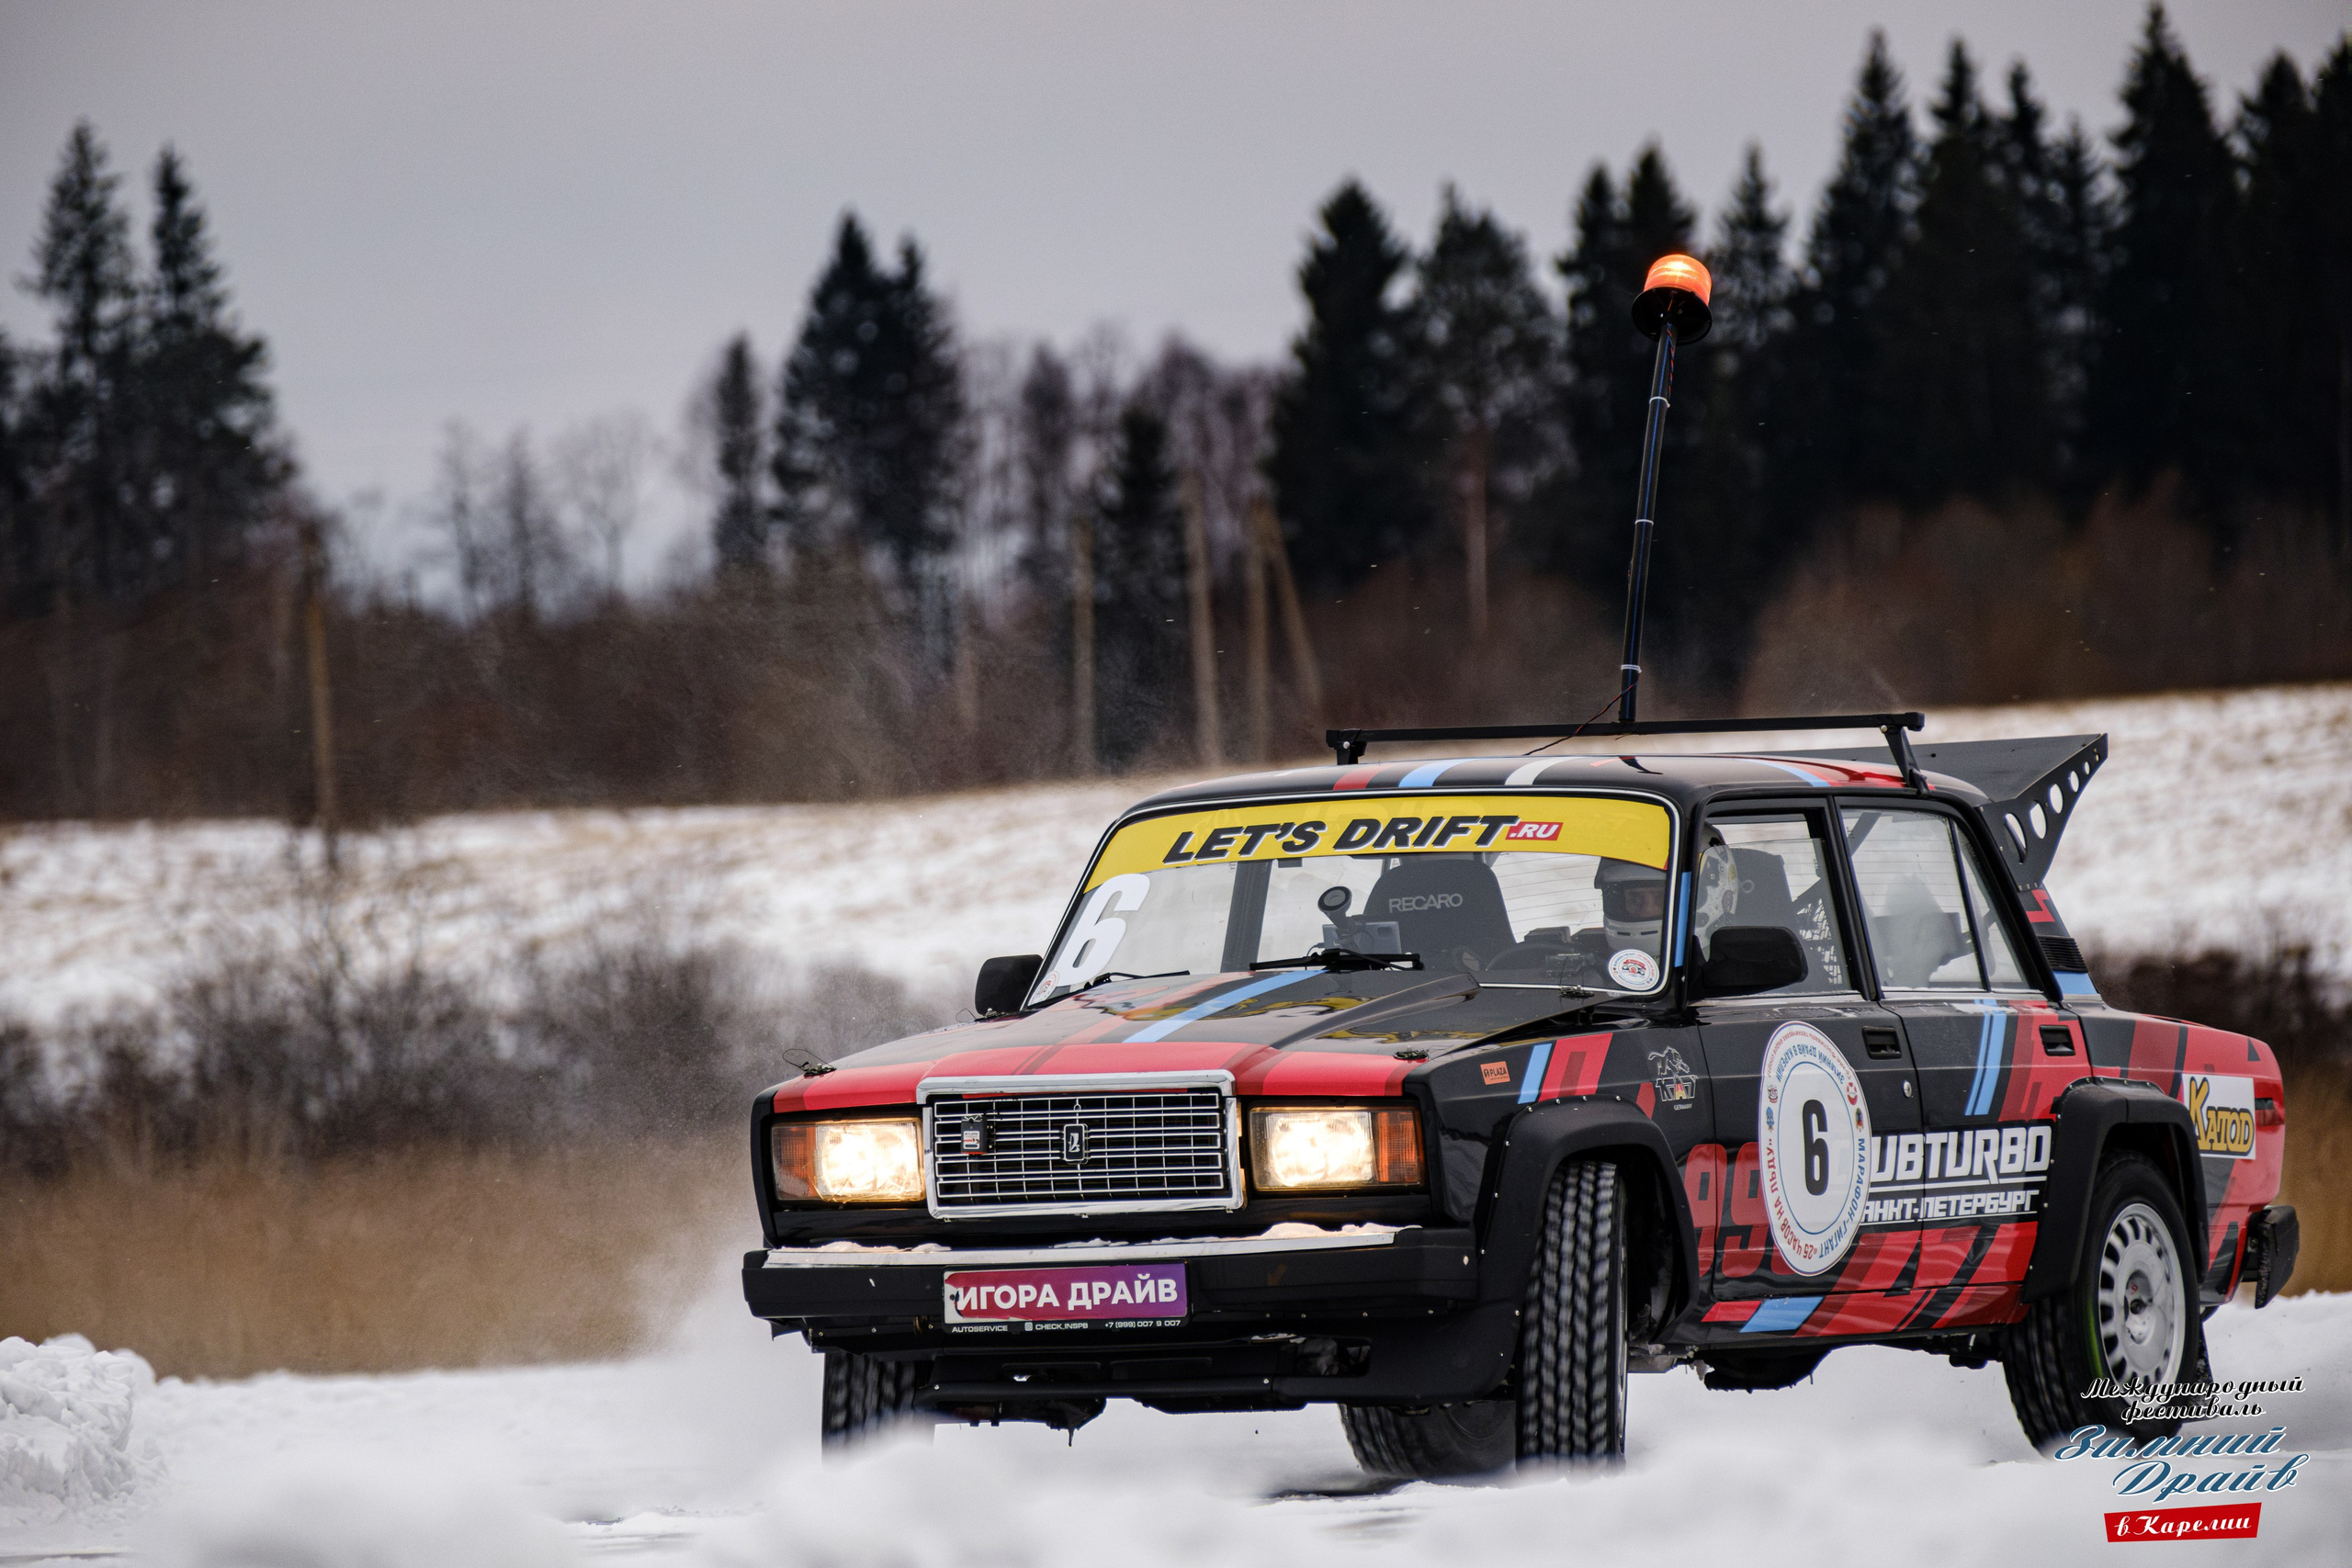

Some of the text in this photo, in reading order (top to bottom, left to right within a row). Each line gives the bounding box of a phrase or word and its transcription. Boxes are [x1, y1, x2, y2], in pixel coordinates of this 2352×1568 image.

[1162, 815, 1560, 864] LET'S DRIFT .RU
[1388, 893, 1464, 914] RECARO
[1056, 874, 1150, 987] 6
[1775, 1047, 1793, 1083] КАРЕЛИИ
[1798, 1043, 1817, 1058] ДРАЙВ
[1818, 1050, 1845, 1085] ЗИМНИЙ
[1803, 1100, 1829, 1196] 6
[1871, 1125, 2052, 1185] UBTURBO
[1684, 1142, 1796, 1279] 99
[1773, 1196, 1785, 1219] НА
[1819, 1138, 1866, 1258] МАРАФОН-ГИГАНТ
[1861, 1190, 2040, 1223] АНКТ-ПЕТЕРБУРГ
[1781, 1217, 1802, 1256] ЧАСОВ
[956, 1273, 1178, 1311] ИГОРА ДРАЙВ
[952, 1325, 1008, 1333] AUTOSERVICE
[1115, 1320, 1136, 1329] (999)
